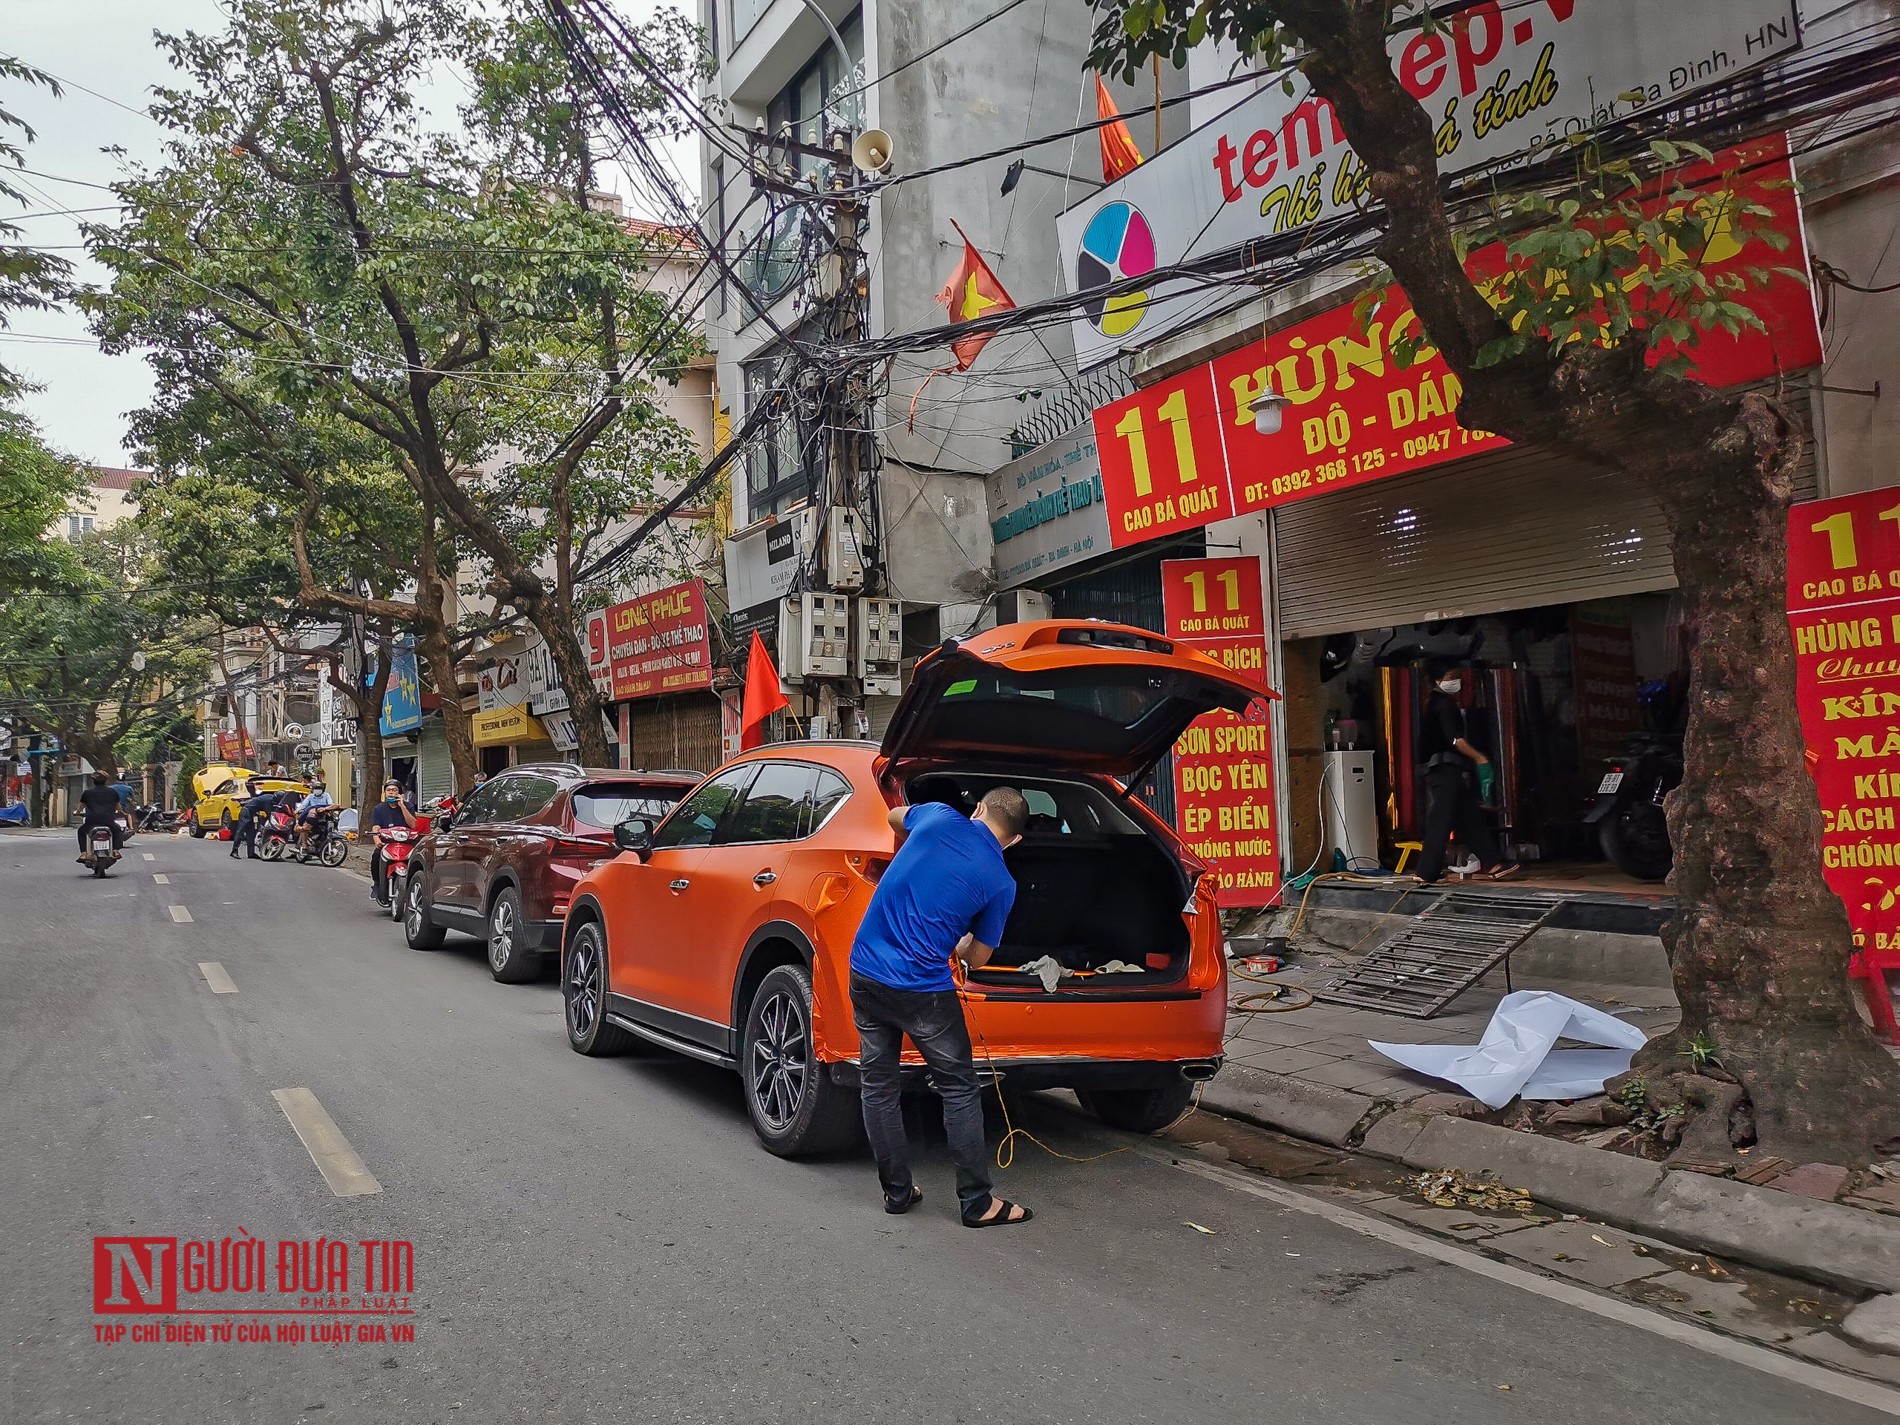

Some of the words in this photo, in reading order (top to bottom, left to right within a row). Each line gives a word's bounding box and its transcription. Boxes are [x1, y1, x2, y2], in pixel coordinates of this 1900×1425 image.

[1669, 50, 1736, 92] Đình,
[1745, 16, 1788, 56] HN
[1473, 41, 1559, 139] tính
[1114, 388, 1198, 498] 11
[1302, 402, 1351, 456] ĐỘ
[1244, 479, 1269, 503] ĐT:
[1271, 469, 1312, 497] 0392
[1315, 459, 1348, 484] 368
[1351, 451, 1386, 474] 125
[1403, 430, 1451, 459] 0947
[1123, 505, 1153, 533] CAO
[1154, 495, 1177, 524] BÁ
[1178, 484, 1219, 518] QUÁT
[768, 533, 791, 552] MILANO
[1183, 569, 1240, 613] 11
[1802, 578, 1846, 600] CAO
[1852, 570, 1883, 593] BÁ
[614, 603, 649, 633] LONG
[651, 589, 692, 622] PHÚC
[1180, 617, 1203, 632] CAO
[1205, 615, 1219, 631] BÁ
[1222, 614, 1250, 631] QUÁT
[589, 618, 605, 664] 9
[683, 623, 704, 643] THAO
[1795, 618, 1883, 656] HÙNG
[1223, 643, 1262, 670] BÍCH
[1177, 726, 1211, 755] SƠN
[1214, 725, 1266, 754] SPORT
[1182, 765, 1222, 798] BỌC
[1228, 759, 1268, 790] YÊN
[1184, 803, 1212, 833] ÉP
[1218, 795, 1270, 832] BIỂN
[1821, 804, 1895, 833] CÁCH
[1235, 835, 1272, 857] NƯỚC
[1236, 868, 1274, 888] HÀNH
